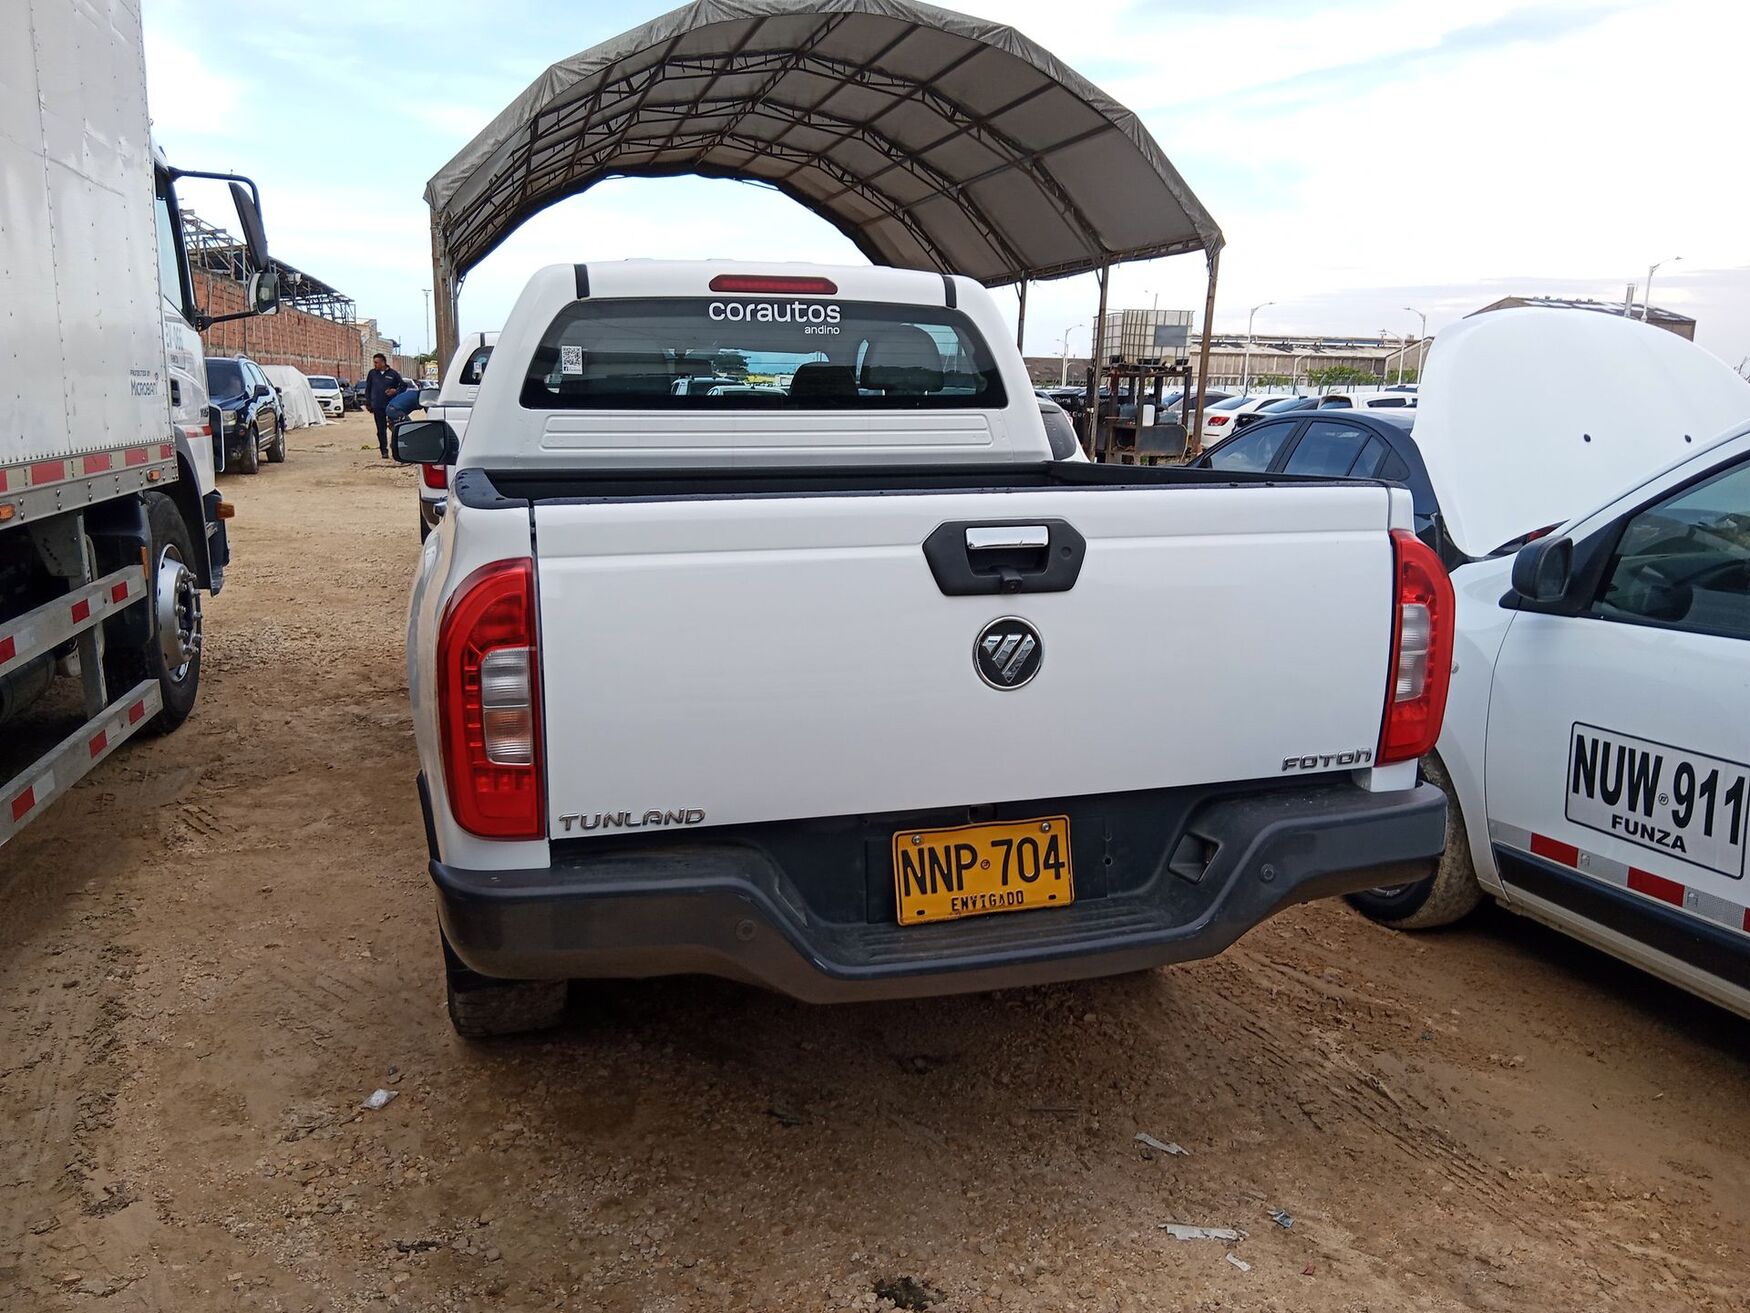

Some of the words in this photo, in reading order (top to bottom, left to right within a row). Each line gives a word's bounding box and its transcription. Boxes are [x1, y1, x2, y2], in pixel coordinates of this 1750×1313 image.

[708, 301, 841, 323] corautos
[804, 325, 840, 335] andino
[1281, 748, 1372, 772] FOTON
[1572, 734, 1663, 818] NUW
[1671, 762, 1746, 845] 911
[558, 807, 706, 831] TUNLAND
[1611, 814, 1687, 853] FUNZA
[901, 843, 978, 897] NNP
[991, 834, 1066, 886] 704
[951, 890, 1025, 912] ENVIGADO
